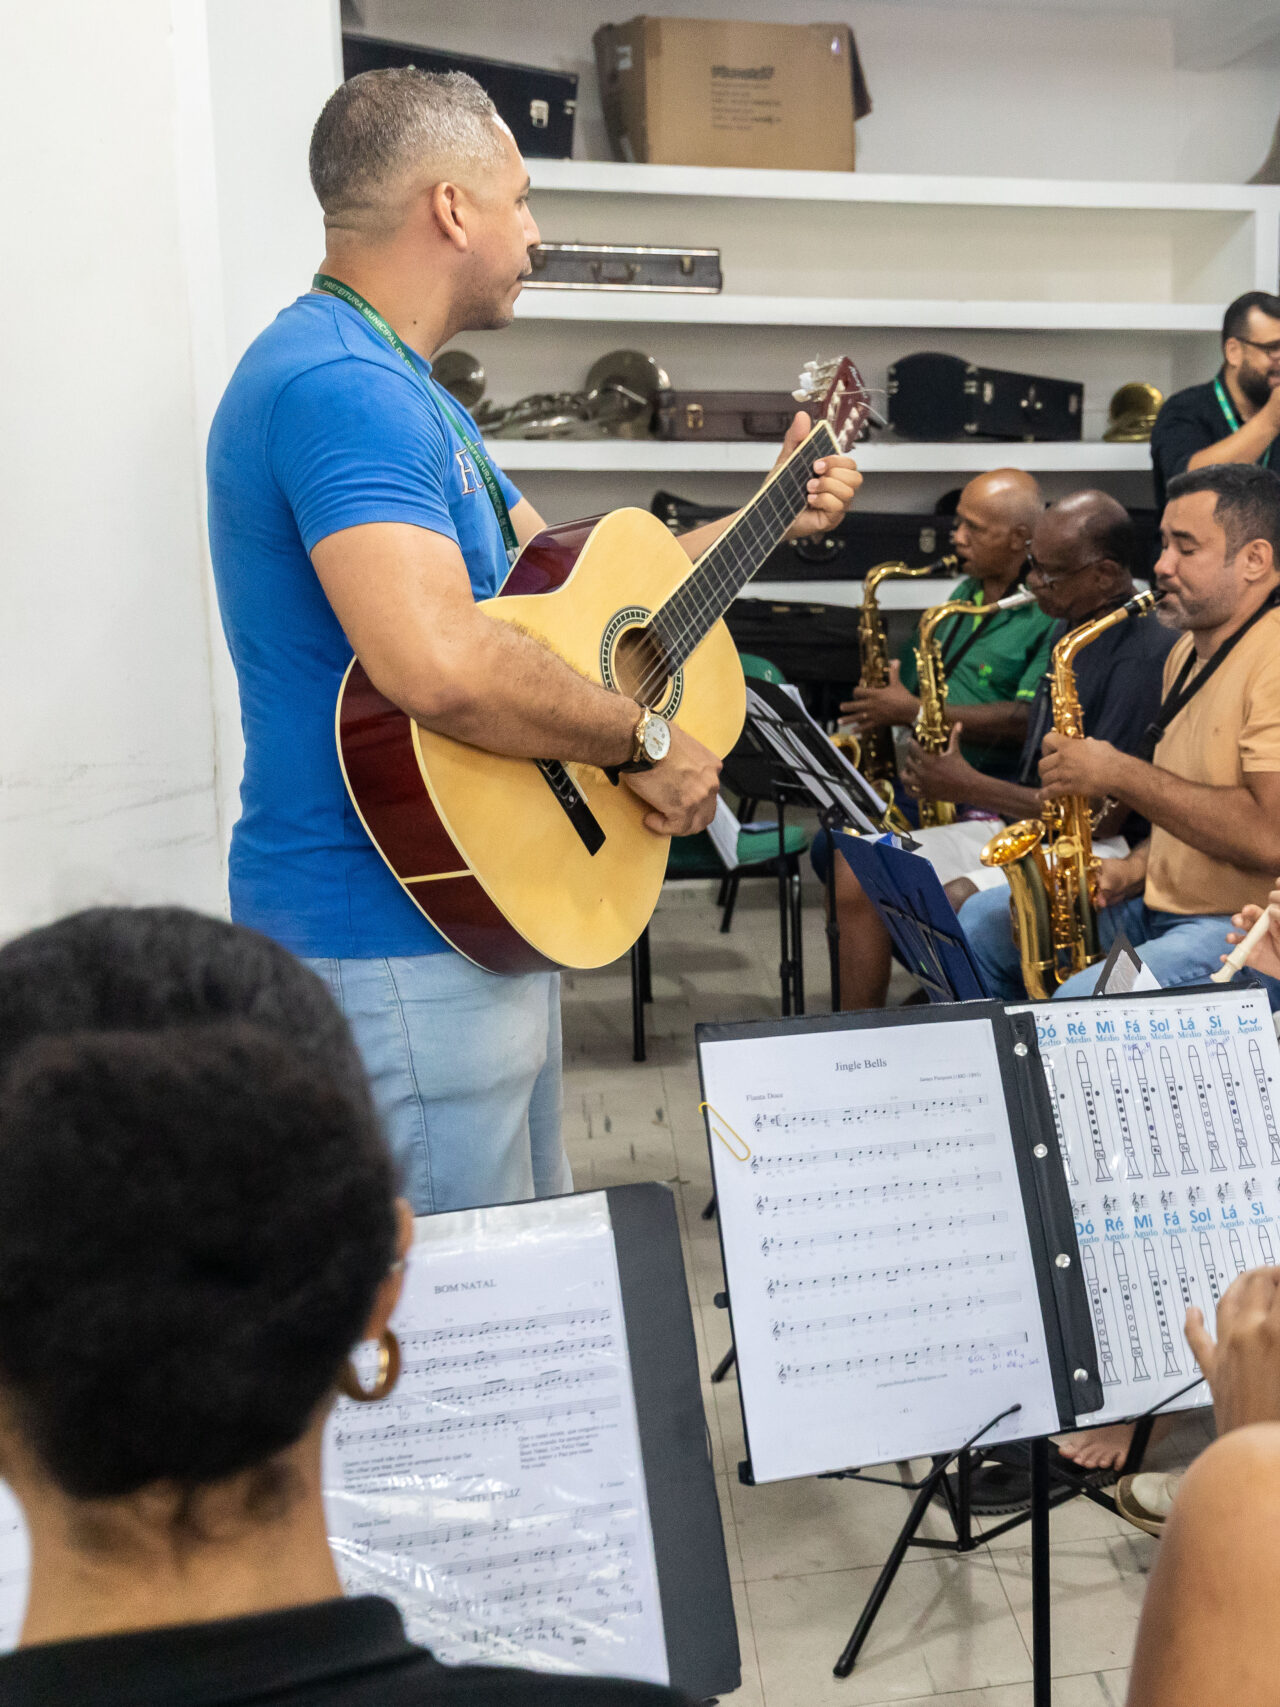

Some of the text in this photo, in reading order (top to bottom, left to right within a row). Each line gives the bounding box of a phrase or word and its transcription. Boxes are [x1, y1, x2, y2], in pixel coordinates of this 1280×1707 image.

[323, 280, 364, 310] PREFEITURA
[362, 307, 398, 348] MUNICIPAL
[462, 435, 493, 484] PREFEITURA
[1067, 1022, 1087, 1036] Ré
[1096, 1020, 1115, 1034] Mi
[1125, 1019, 1141, 1033] Fá
[1149, 1018, 1170, 1033] Sol
[1179, 1017, 1196, 1031] Lá
[1209, 1015, 1222, 1029] Si
[1237, 1024, 1263, 1035] Agudo
[834, 1058, 888, 1073] Jingle Bells
[1104, 1216, 1124, 1232] Ré
[1133, 1214, 1153, 1229] Mi
[1163, 1211, 1180, 1226] Fá
[1189, 1207, 1211, 1224] Sol
[1221, 1204, 1238, 1220] Lá
[1251, 1201, 1265, 1216] Si
[1104, 1231, 1130, 1242] Agudo
[1133, 1229, 1159, 1240] Agudo
[1162, 1226, 1187, 1236] Agudo
[1190, 1222, 1216, 1233] Agudo
[1219, 1219, 1245, 1230] Agudo
[1248, 1216, 1274, 1226] Agudo
[434, 1279, 497, 1295] BOM NATAL
